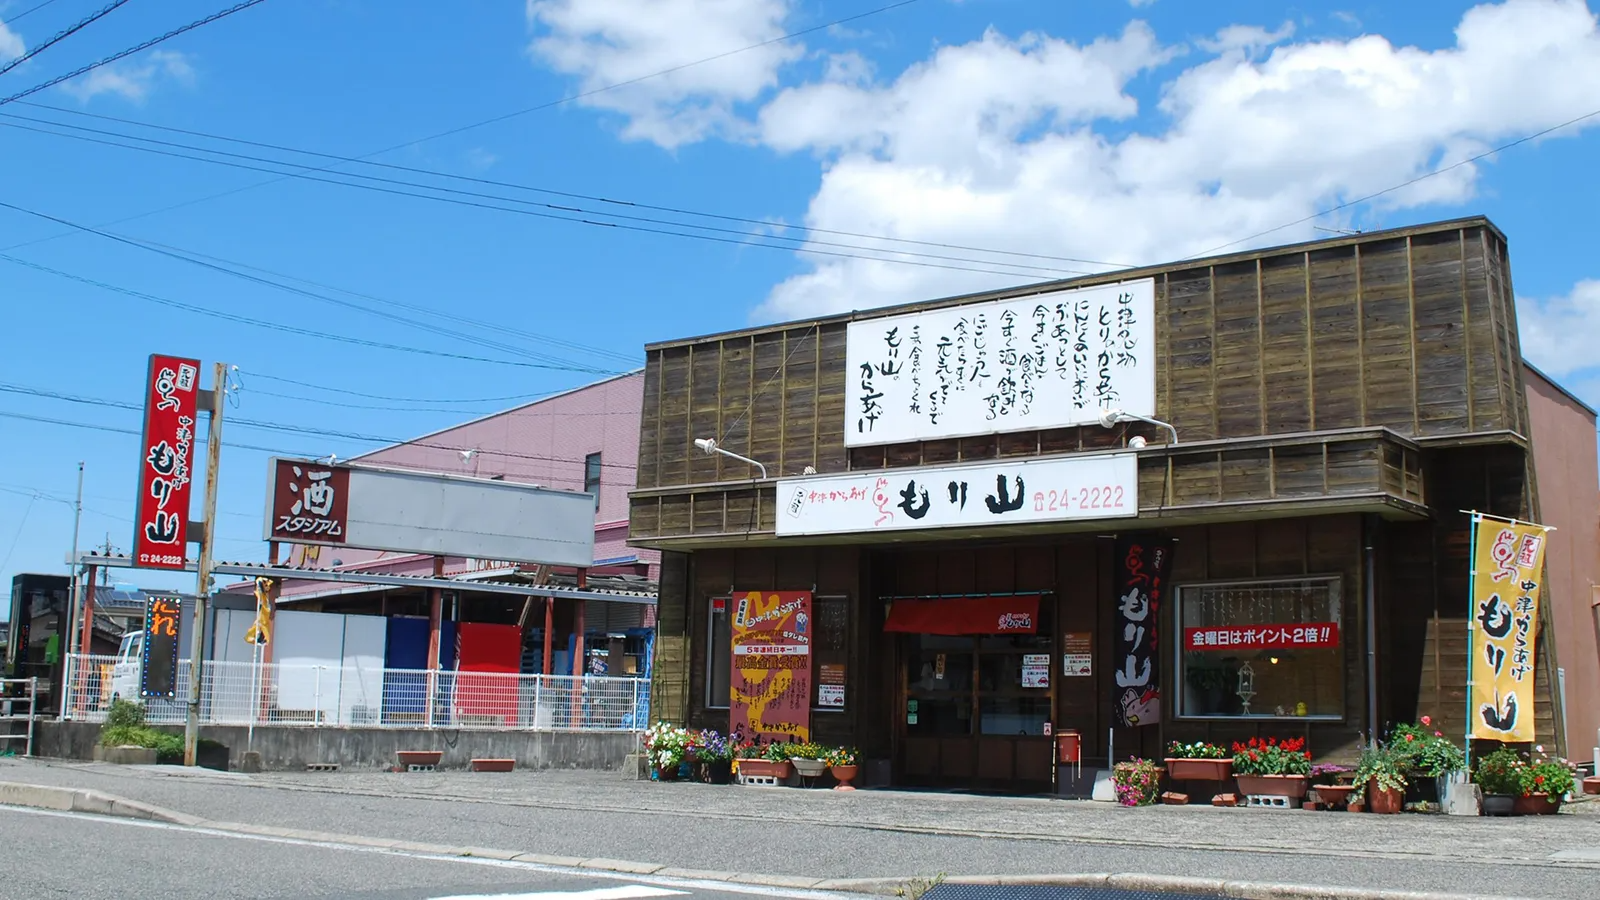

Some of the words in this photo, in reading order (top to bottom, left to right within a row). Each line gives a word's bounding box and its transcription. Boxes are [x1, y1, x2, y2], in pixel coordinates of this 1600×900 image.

[173, 416, 193, 490] 中津からあげ
[145, 441, 179, 544] もり山
[289, 465, 335, 516] 酒
[808, 486, 869, 503] 中津からあげ
[897, 474, 1025, 520] もり山
[1048, 485, 1124, 511] 24-2222
[275, 515, 342, 536] スタジアム
[150, 555, 182, 565] 24-2222
[1520, 539, 1535, 566] 元祖
[1115, 587, 1152, 688] もり山
[1192, 627, 1331, 647] 金曜日はポイント2倍!!
[1512, 579, 1537, 681] 中津からあげ
